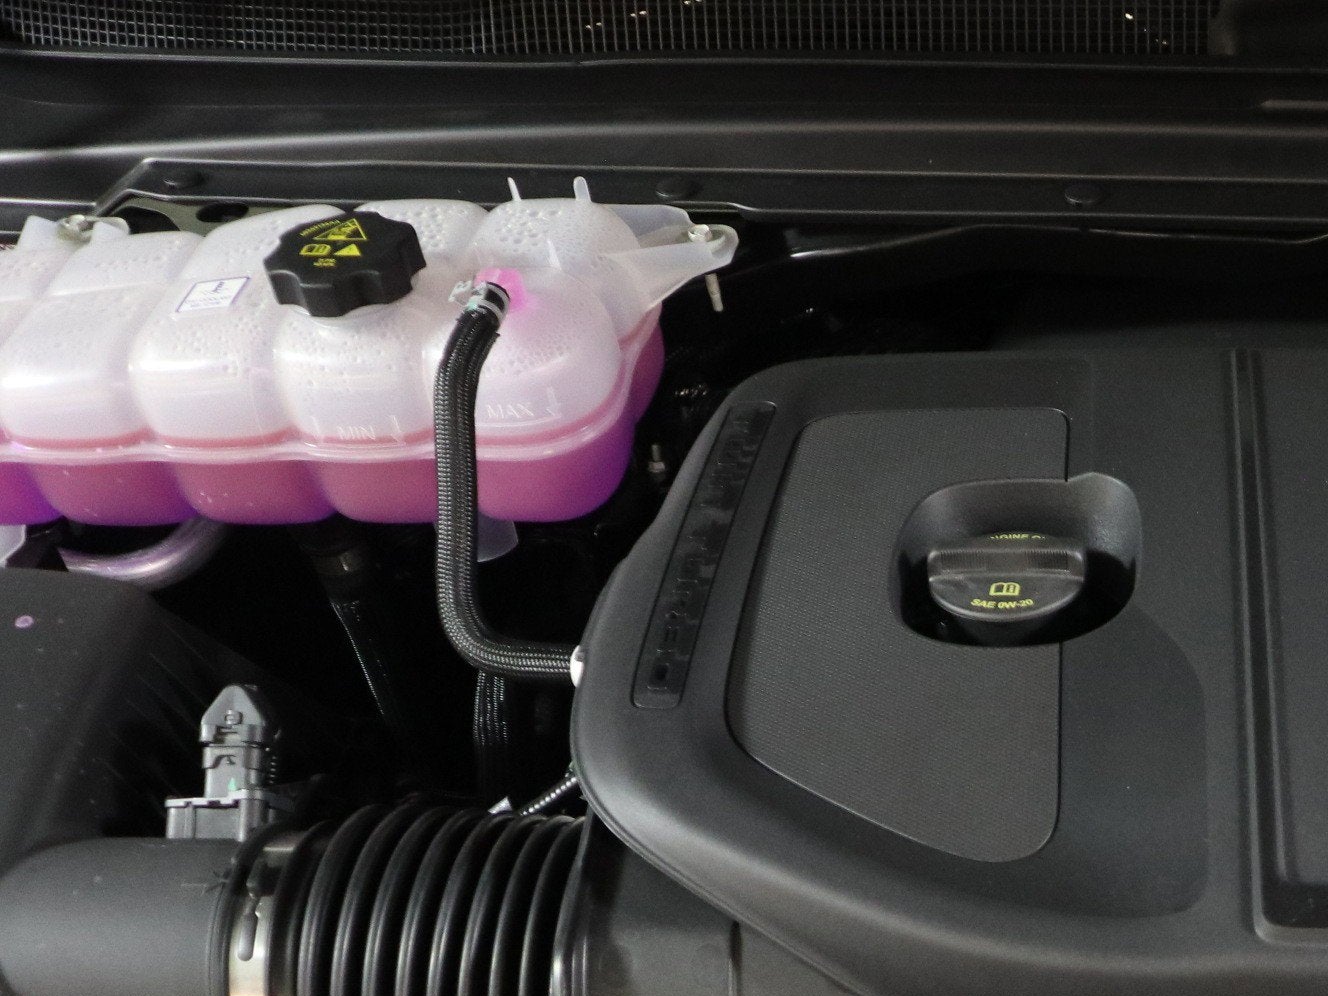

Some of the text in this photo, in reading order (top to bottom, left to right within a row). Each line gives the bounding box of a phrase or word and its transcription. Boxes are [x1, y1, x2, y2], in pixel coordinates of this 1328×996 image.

[485, 403, 535, 419] MAX
[336, 426, 377, 441] MIN
[970, 598, 1034, 608] SAE 0W-20
